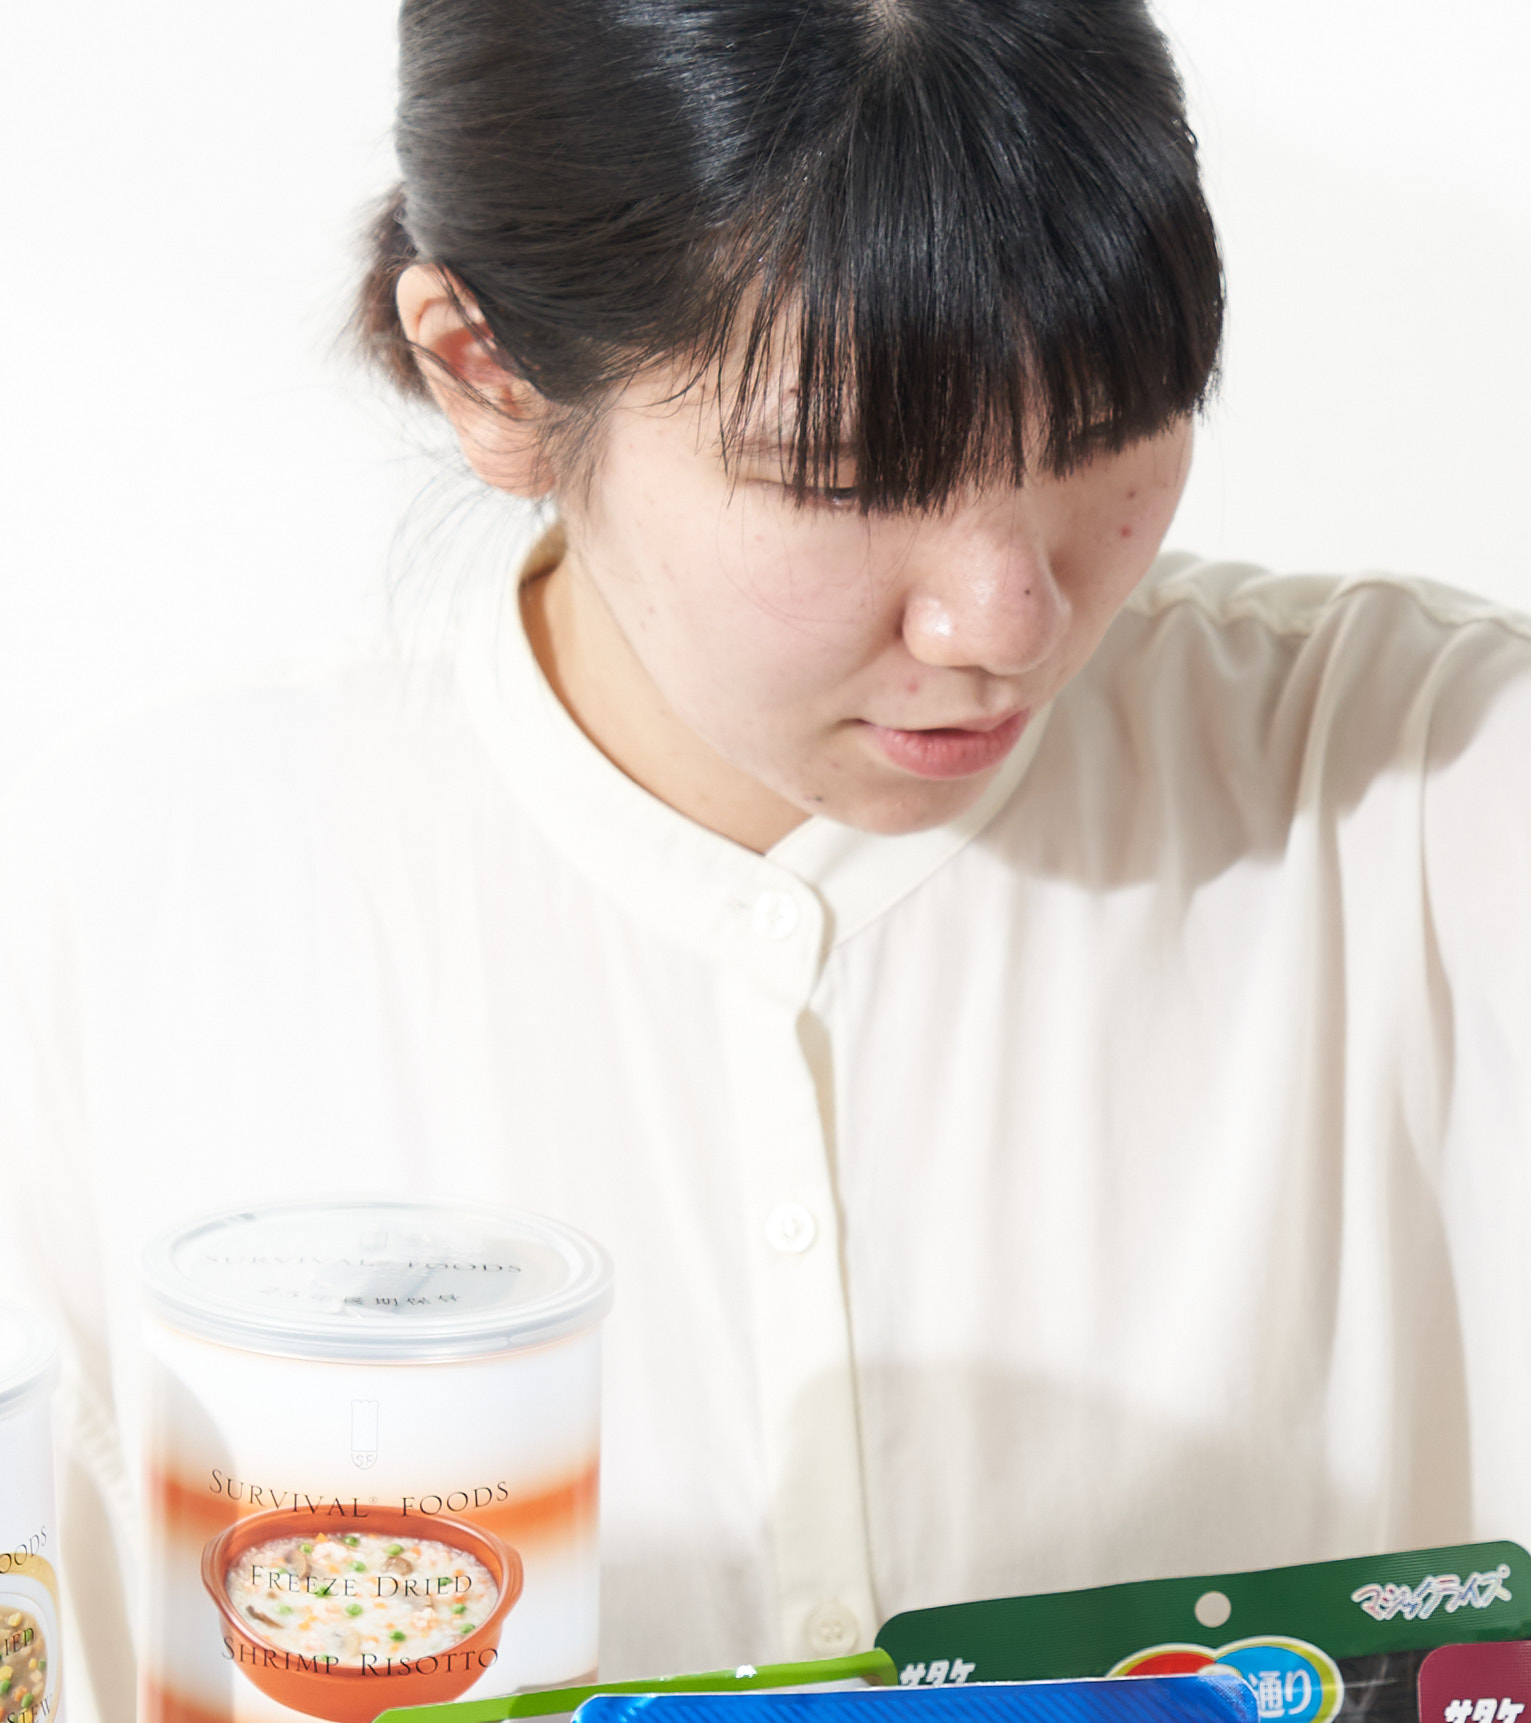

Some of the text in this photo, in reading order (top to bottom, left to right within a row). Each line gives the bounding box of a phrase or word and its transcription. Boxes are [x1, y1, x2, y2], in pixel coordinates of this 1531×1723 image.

[207, 1468, 510, 1519] SURVIVAL FOODS
[249, 1563, 473, 1598] FREEZE DRIED
[1350, 1563, 1512, 1622] マジックライス
[222, 1636, 501, 1677] SHRIMP RISOTTO
[898, 1657, 977, 1688] サタケ
